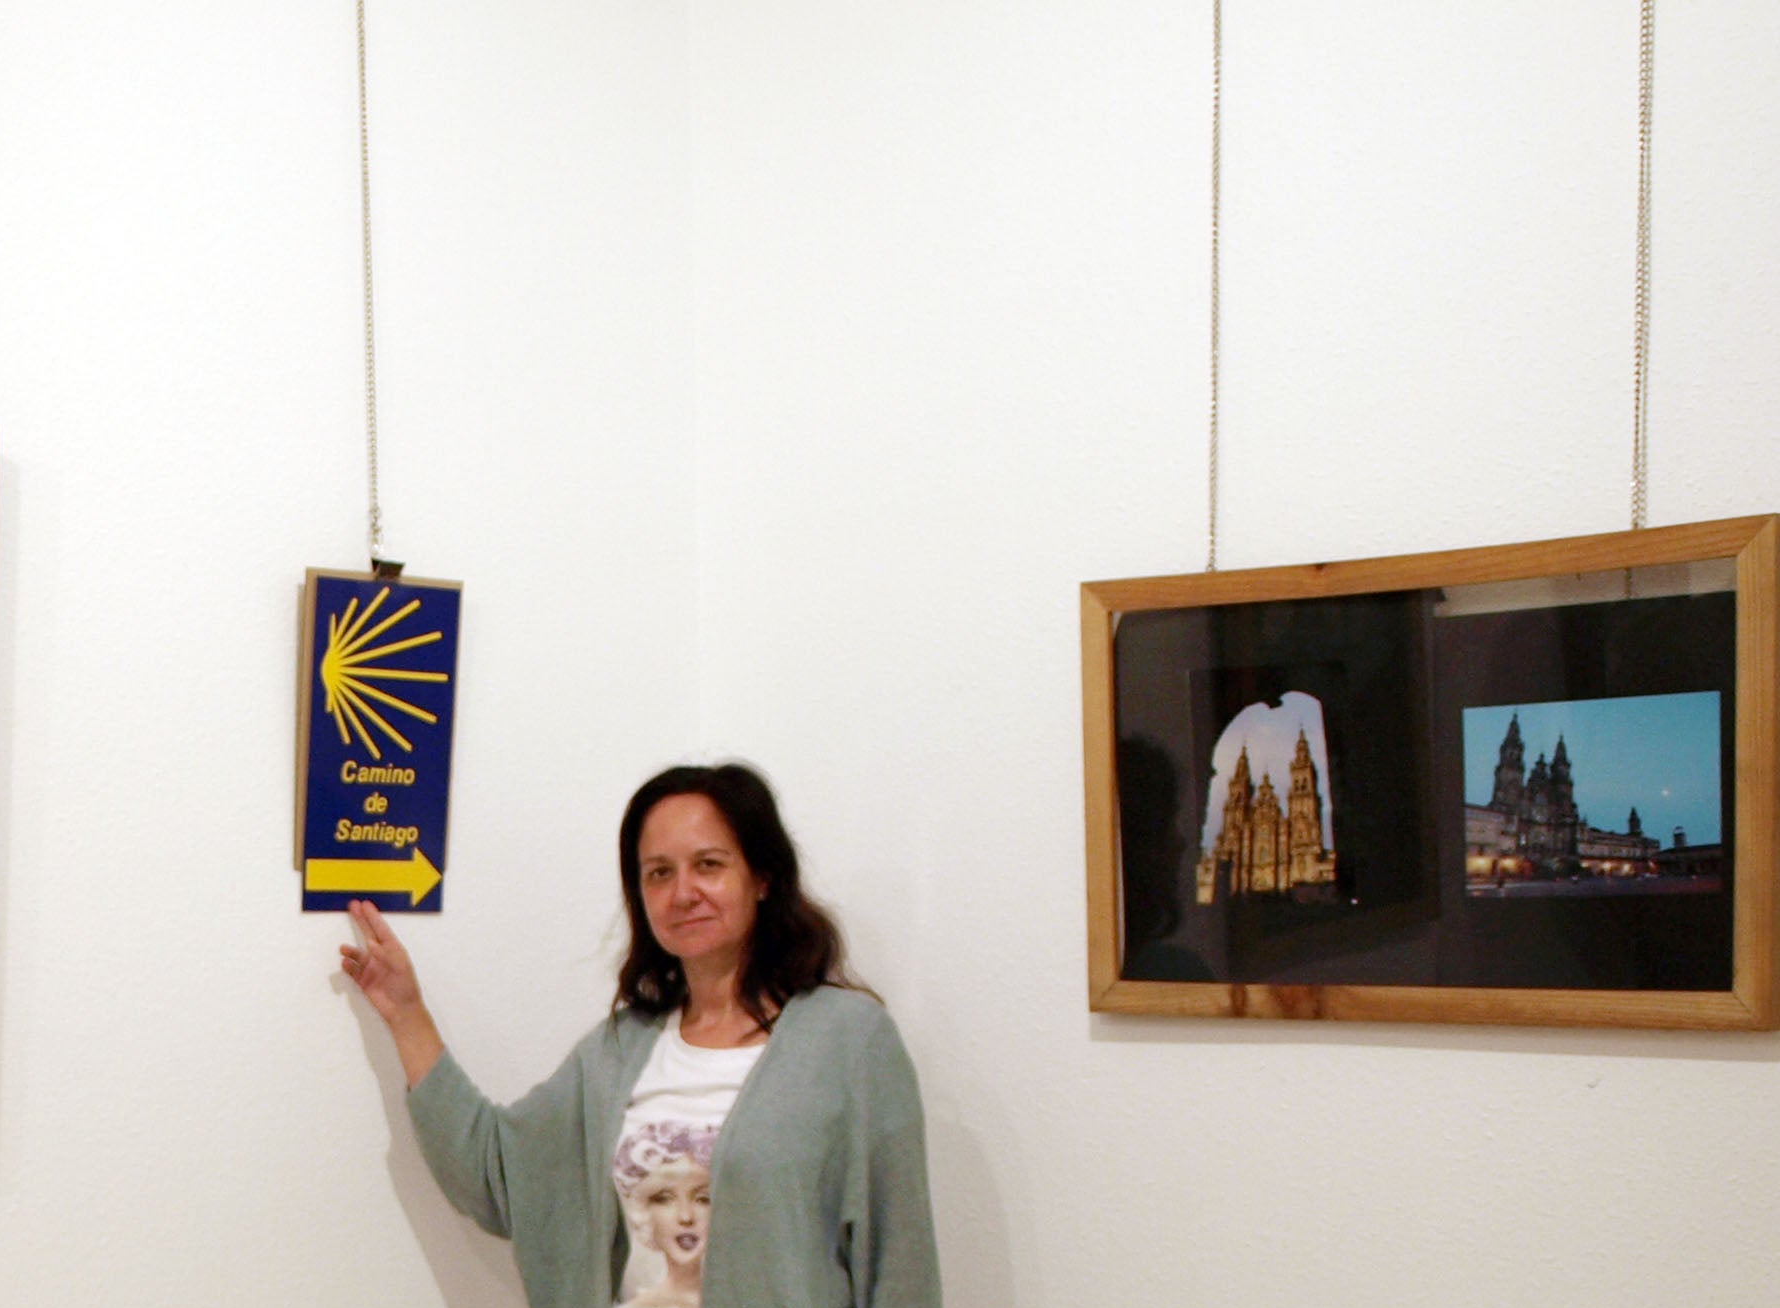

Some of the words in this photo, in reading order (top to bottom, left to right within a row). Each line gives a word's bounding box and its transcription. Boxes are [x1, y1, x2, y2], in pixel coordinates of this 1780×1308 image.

[341, 760, 416, 785] Camino
[364, 792, 388, 813] de
[335, 818, 419, 847] Santiago
